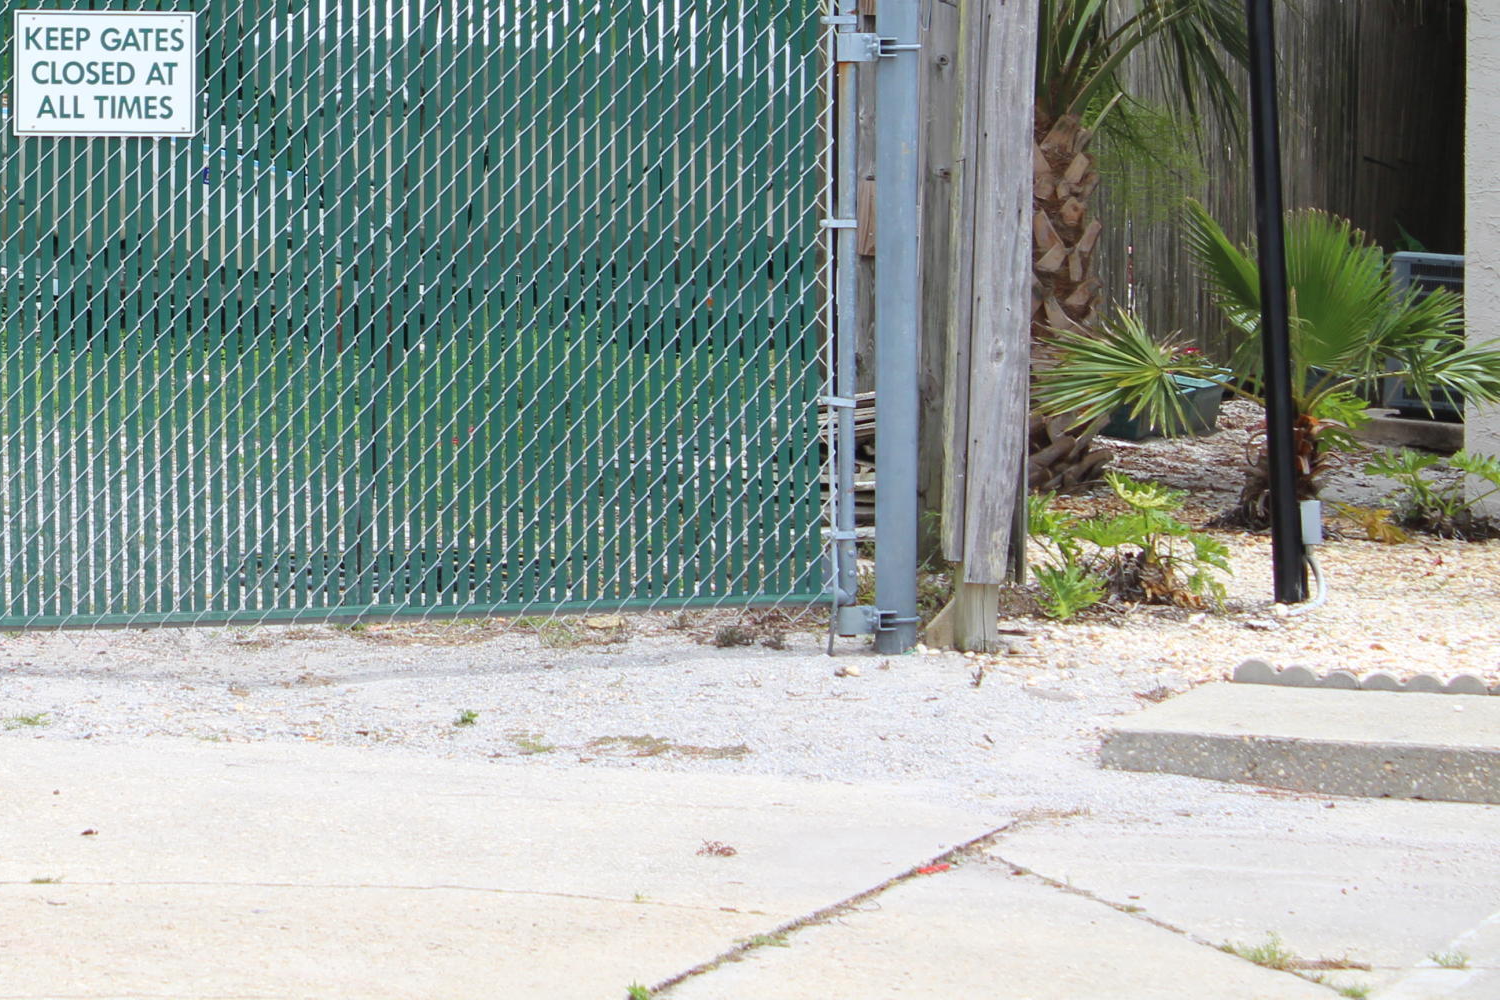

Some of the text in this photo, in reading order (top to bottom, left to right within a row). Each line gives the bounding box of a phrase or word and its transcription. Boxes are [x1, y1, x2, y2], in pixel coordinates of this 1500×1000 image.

[24, 26, 185, 52] KEEP GATES
[31, 60, 178, 85] CLOSED AT
[36, 95, 174, 120] ALL TIMES
